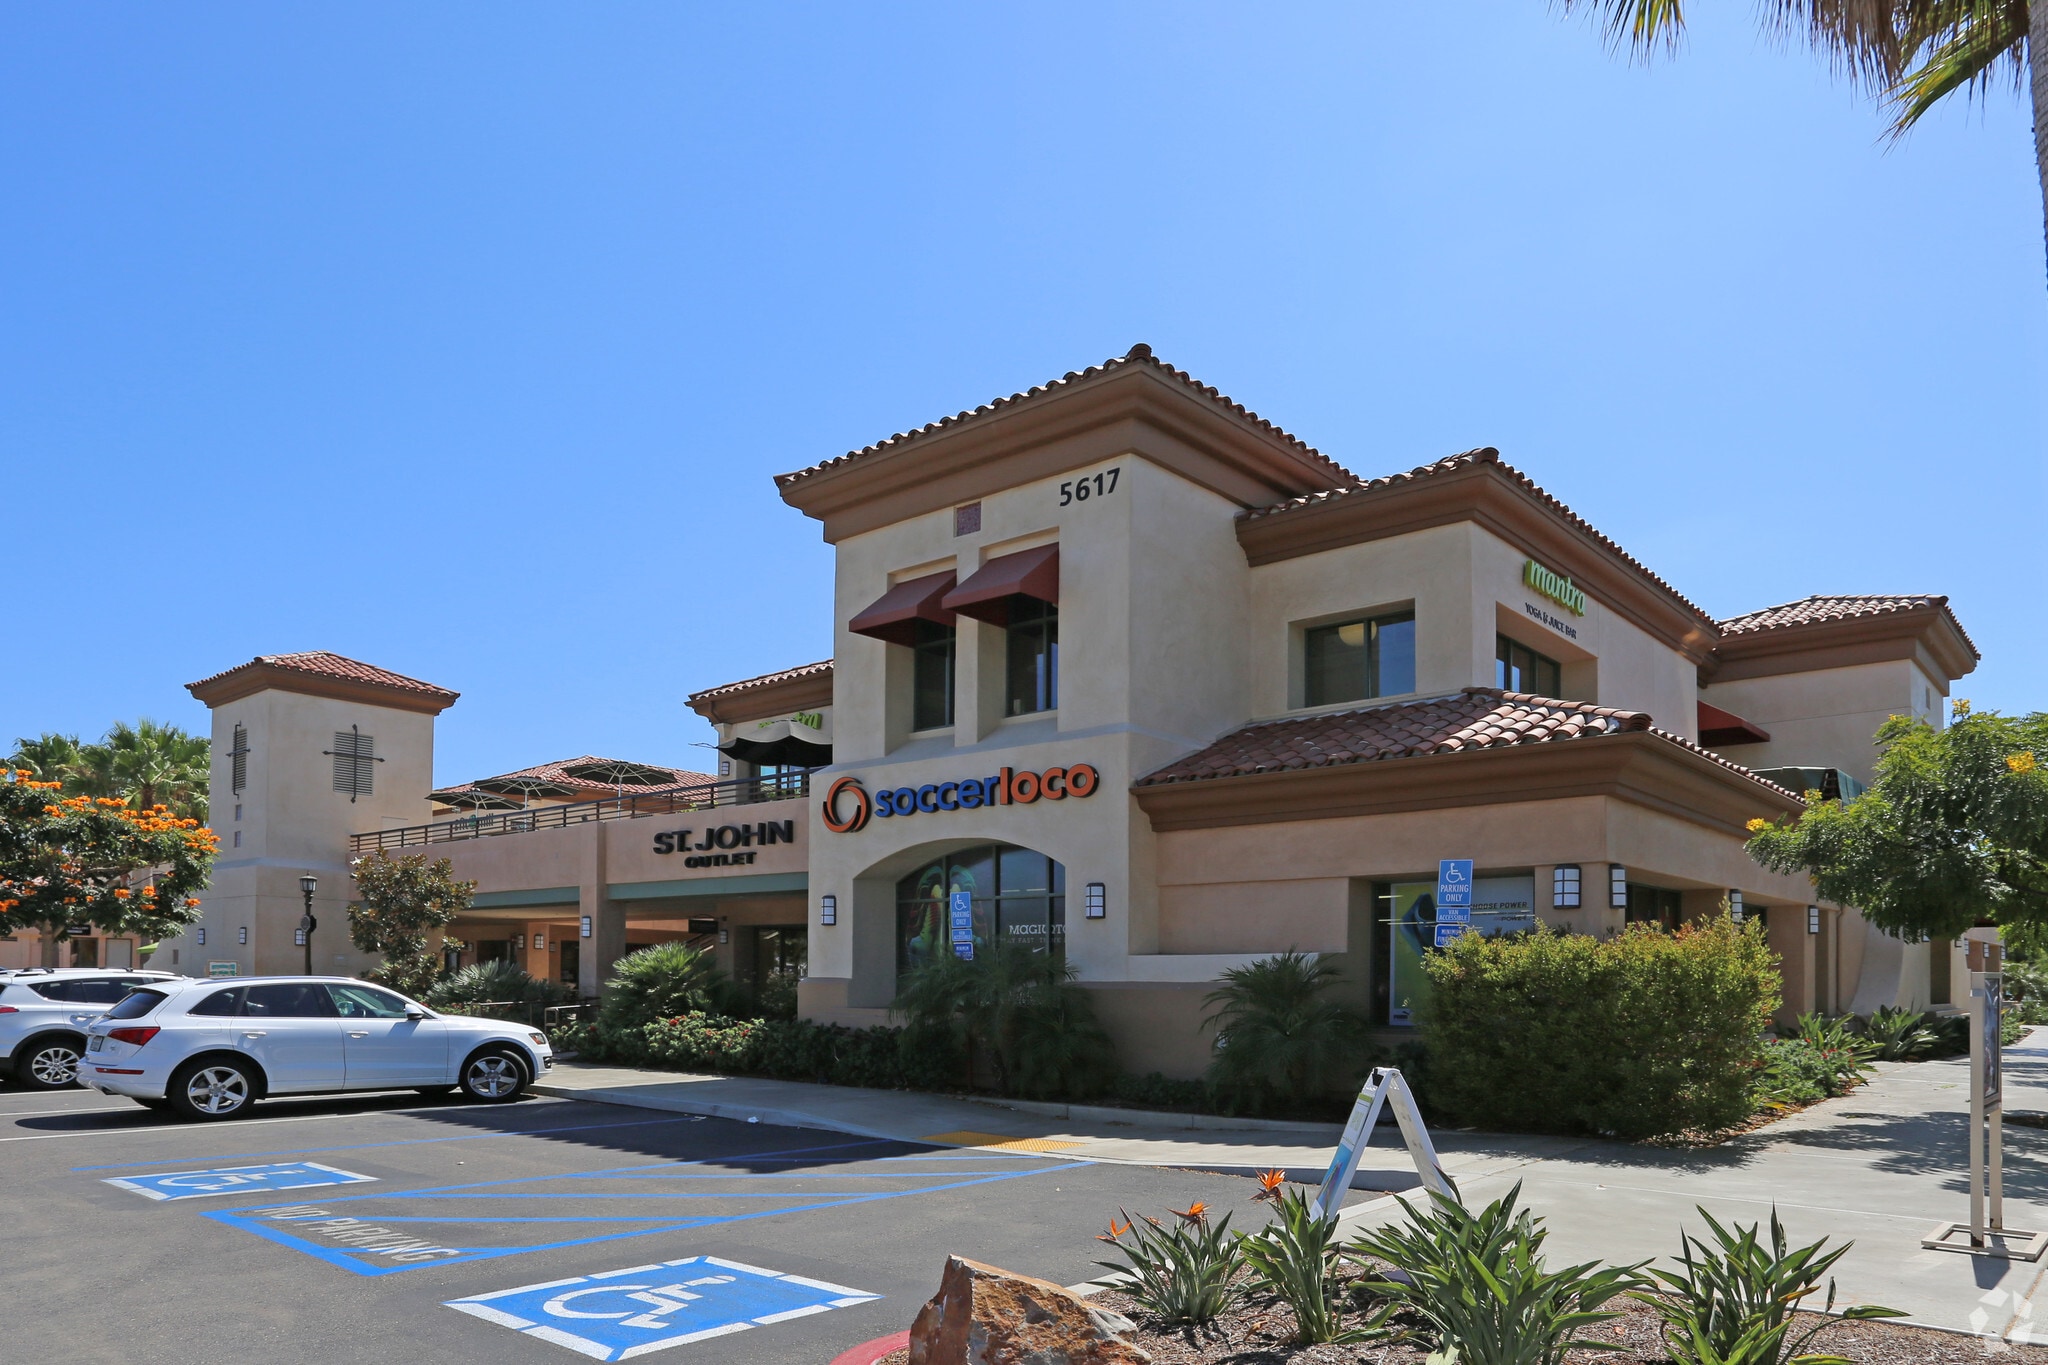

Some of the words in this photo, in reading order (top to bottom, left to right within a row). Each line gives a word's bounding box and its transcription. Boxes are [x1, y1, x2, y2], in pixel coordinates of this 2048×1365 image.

[1060, 467, 1120, 507] 5617
[1525, 559, 1585, 617] mantra
[1525, 602, 1542, 621] YOGA
[1549, 617, 1565, 633] JUICE
[1565, 624, 1577, 640] BAR
[875, 763, 1098, 818] soccerloco
[684, 851, 757, 869] OUTLET
[1440, 884, 1469, 893] PARKING
[1445, 893, 1463, 902] ONLY
[1499, 901, 1528, 909] POWER
[253, 1204, 332, 1220] NO
[293, 1217, 461, 1262] PARKING
